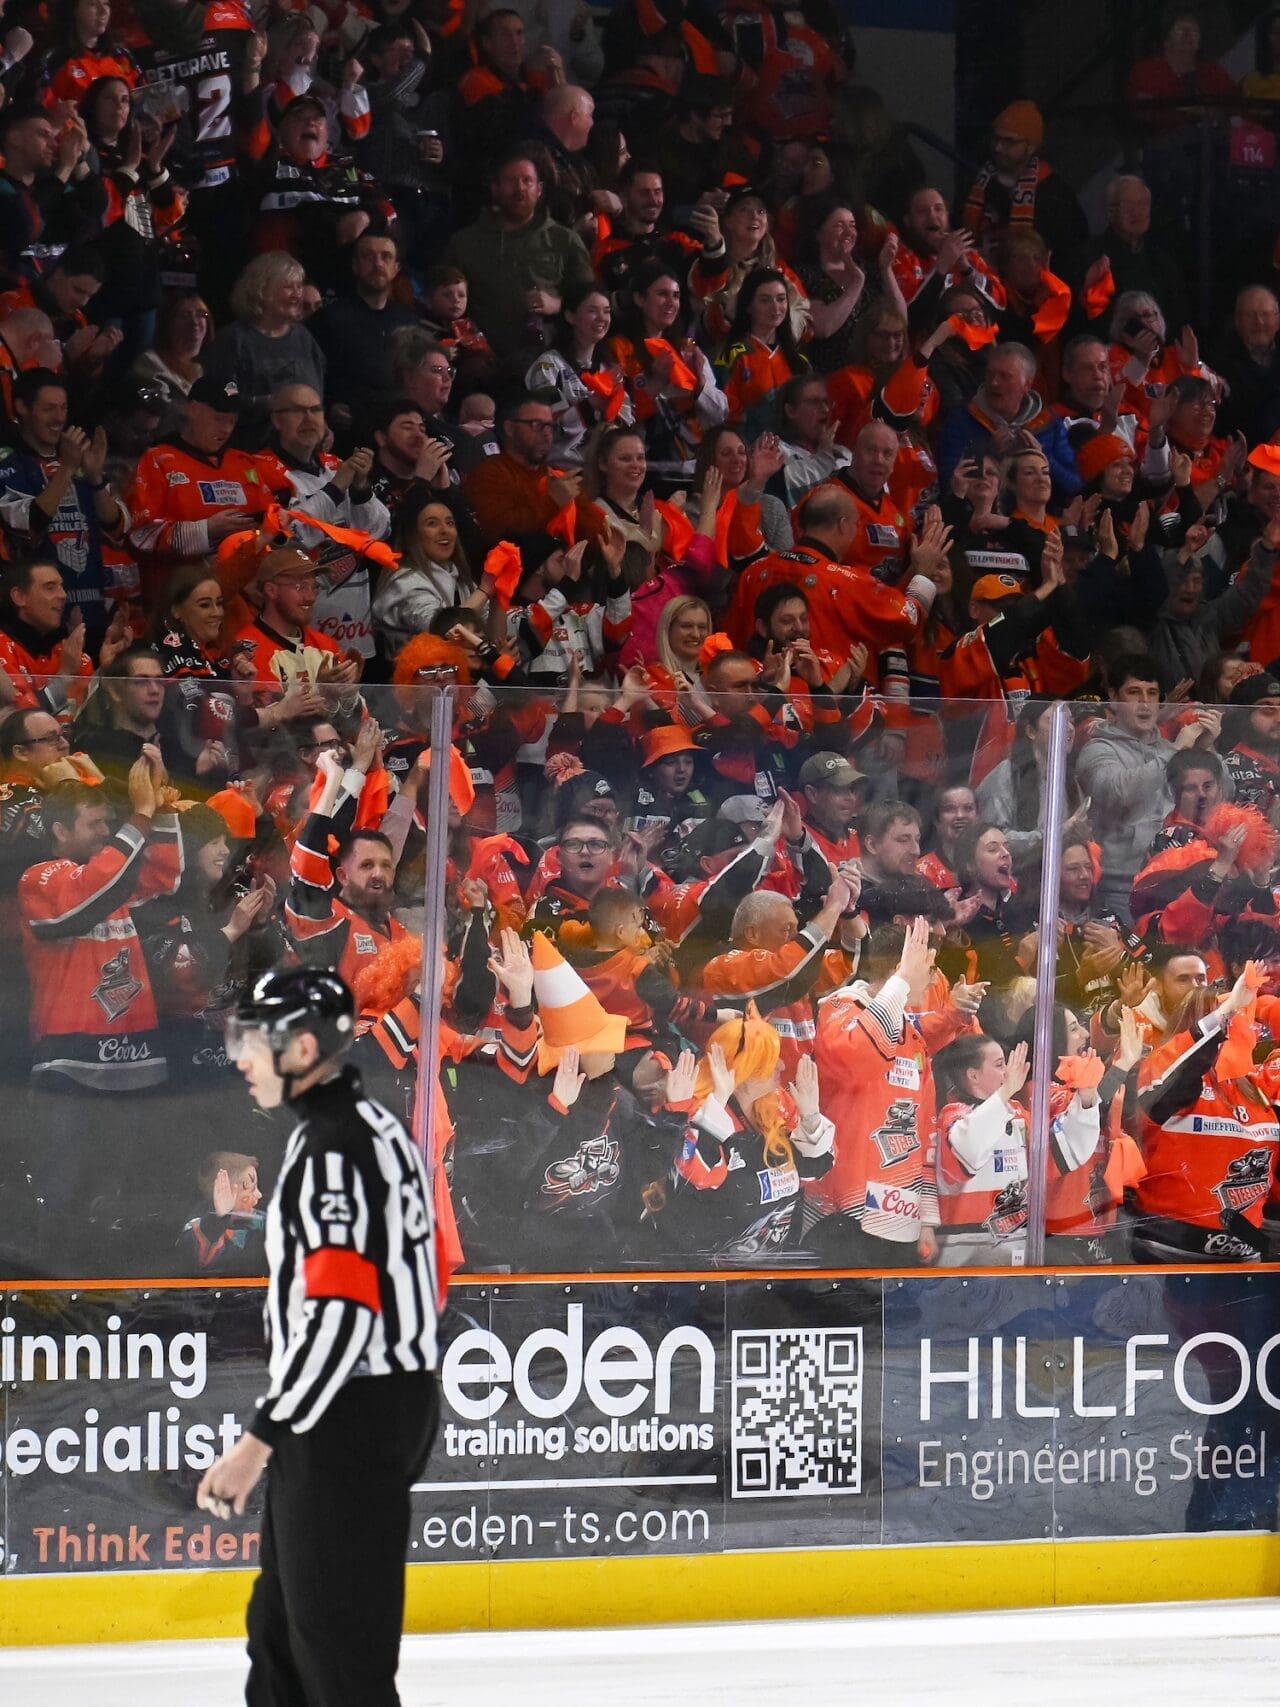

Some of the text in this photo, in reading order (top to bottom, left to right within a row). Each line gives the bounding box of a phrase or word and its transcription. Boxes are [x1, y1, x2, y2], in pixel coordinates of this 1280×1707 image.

[1242, 146, 1264, 163] 114
[98, 1038, 150, 1062] Coors
[320, 1193, 351, 1221] 25
[1227, 1183, 1269, 1208] STEELERS
[442, 1302, 715, 1421] eden
[0, 1407, 243, 1476] ecialist
[444, 1415, 715, 1460] training solutions
[919, 1430, 1266, 1501] Engineering Steel
[33, 1524, 151, 1563] Think
[165, 1522, 260, 1562] Eden
